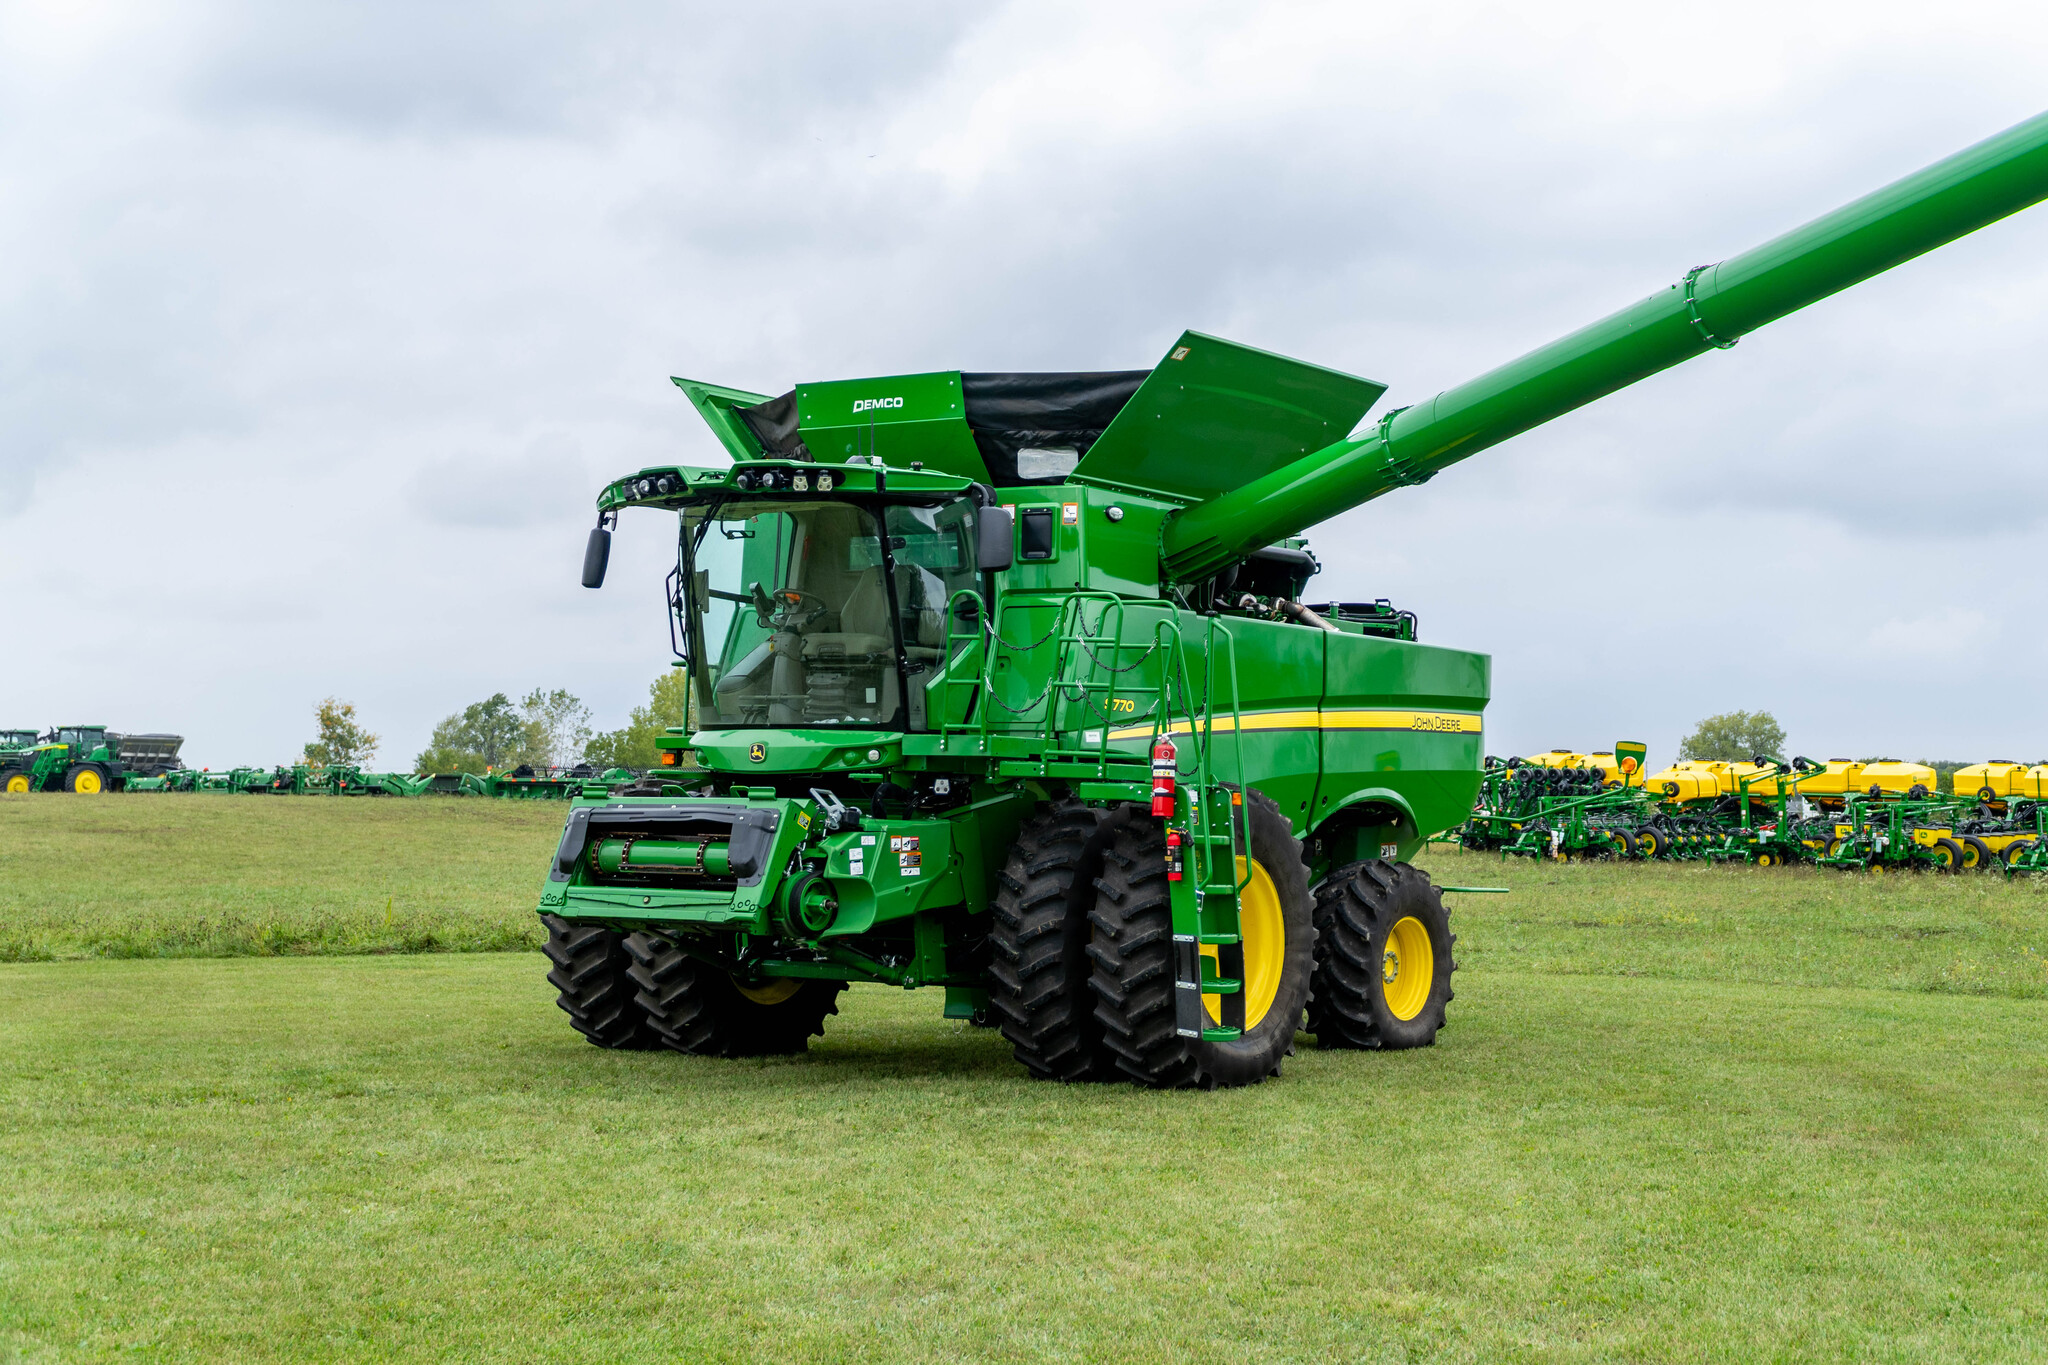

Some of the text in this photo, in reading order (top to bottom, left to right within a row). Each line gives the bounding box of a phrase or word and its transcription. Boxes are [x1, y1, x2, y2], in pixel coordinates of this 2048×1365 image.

[852, 396, 904, 413] DEMCO
[1411, 714, 1462, 731] JOHN DEERE
